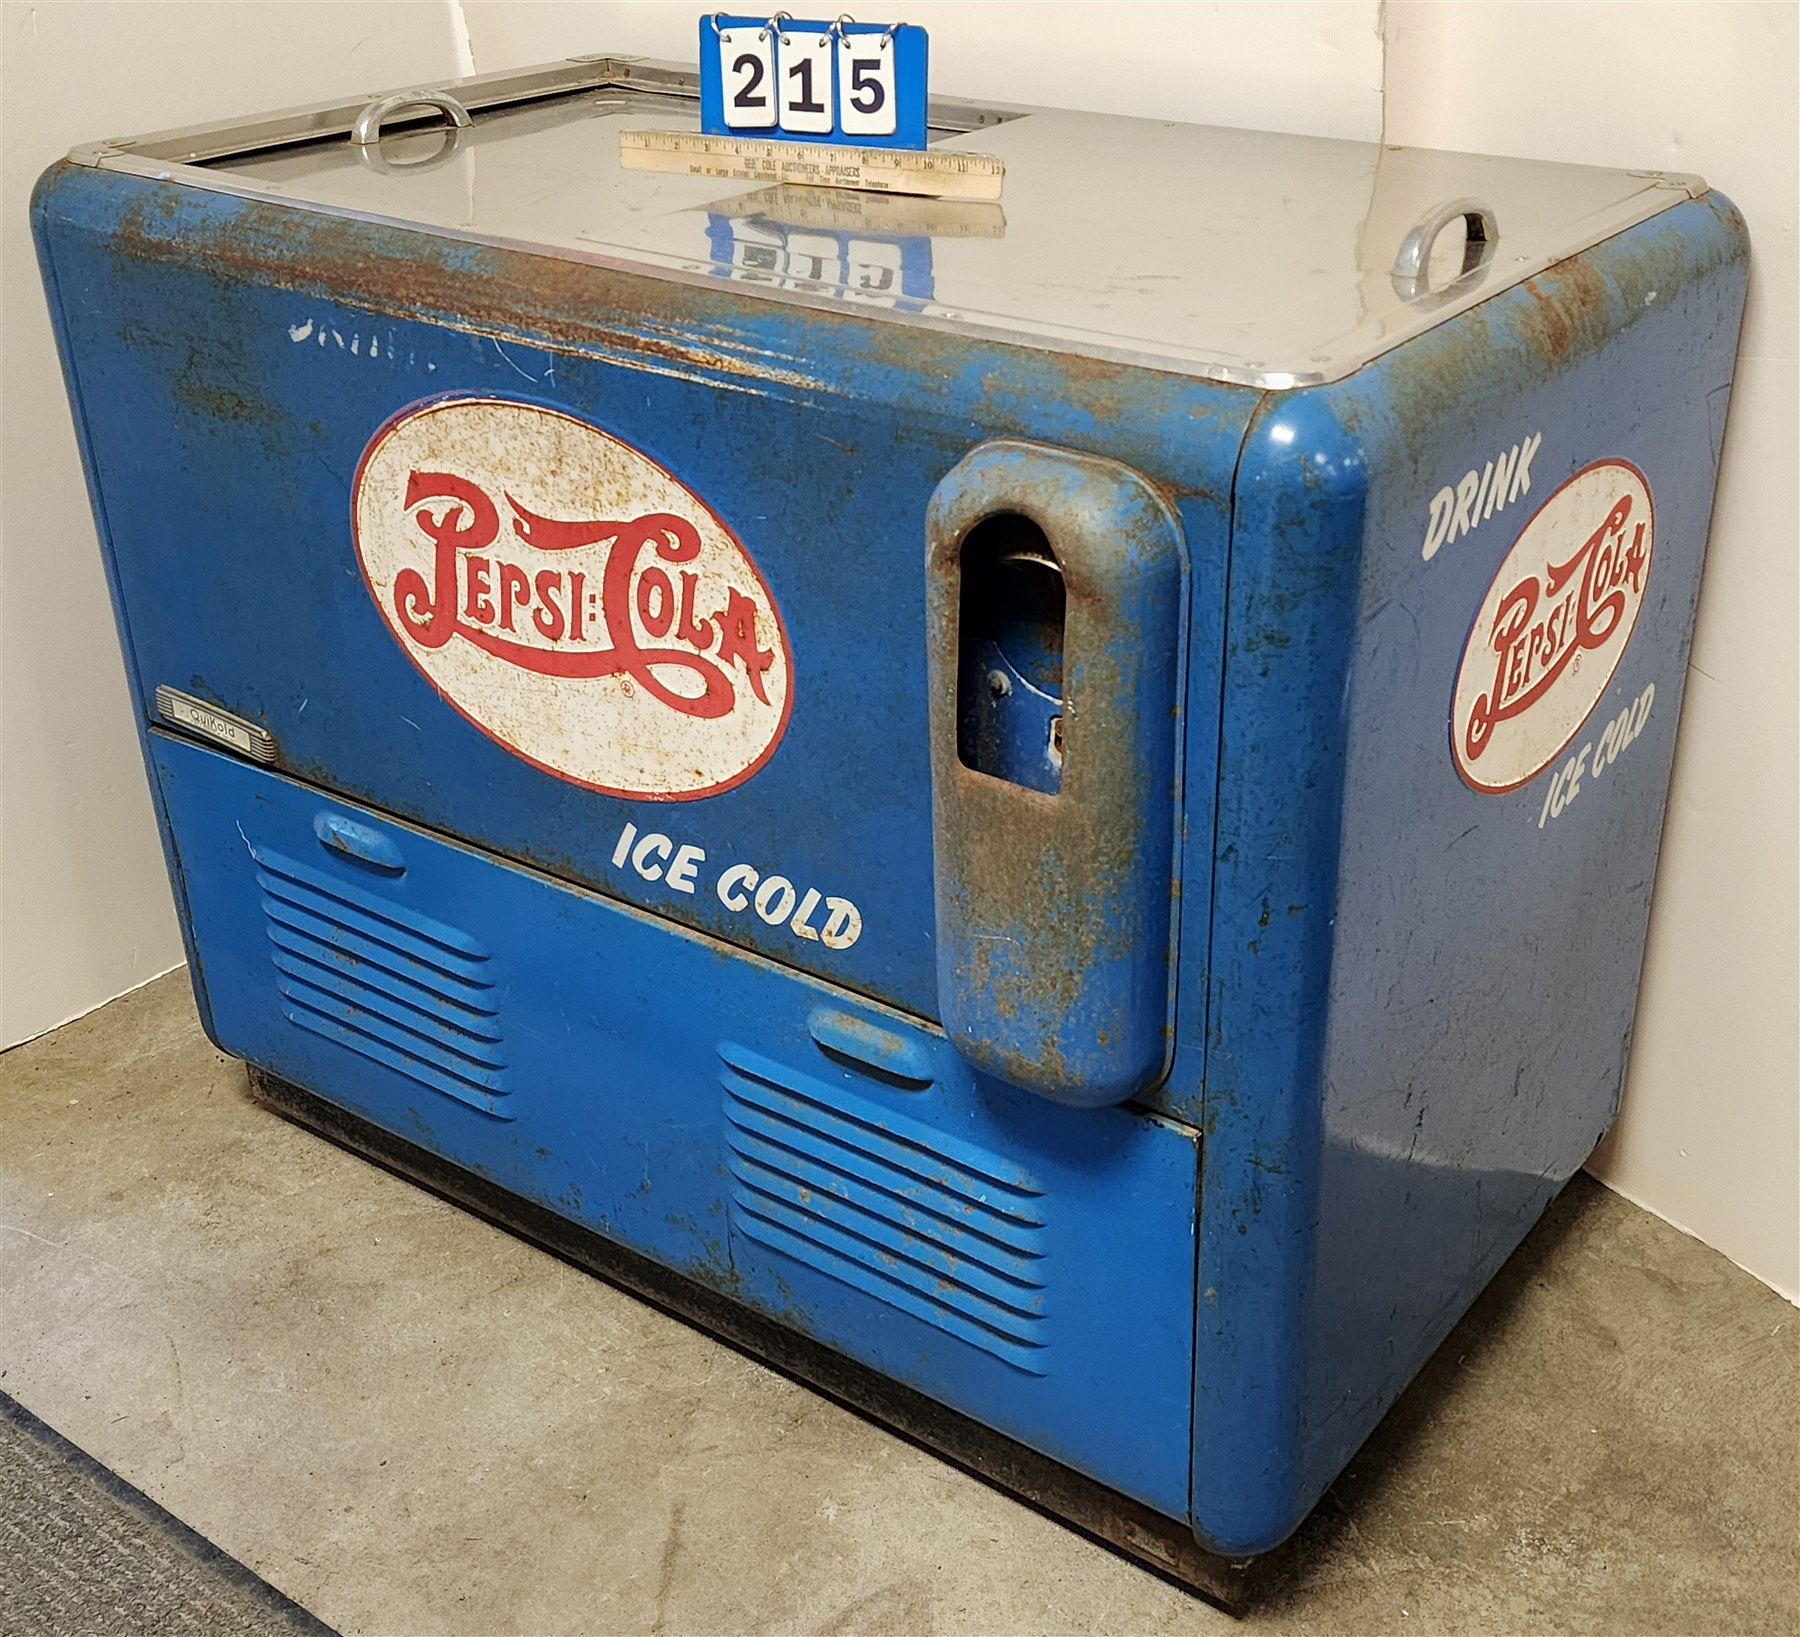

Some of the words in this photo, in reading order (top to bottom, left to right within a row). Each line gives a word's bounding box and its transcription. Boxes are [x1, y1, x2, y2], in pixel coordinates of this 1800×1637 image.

[731, 52, 886, 115] 215
[893, 158, 900, 168] 9
[923, 160, 933, 170] 10
[957, 161, 967, 172] 11
[991, 165, 1001, 175] 12
[1421, 431, 1542, 562] DRINK
[1538, 741, 1592, 829] ICE
[1590, 682, 1655, 779] COLD
[611, 822, 706, 894] ICE
[716, 863, 862, 950] COLD
